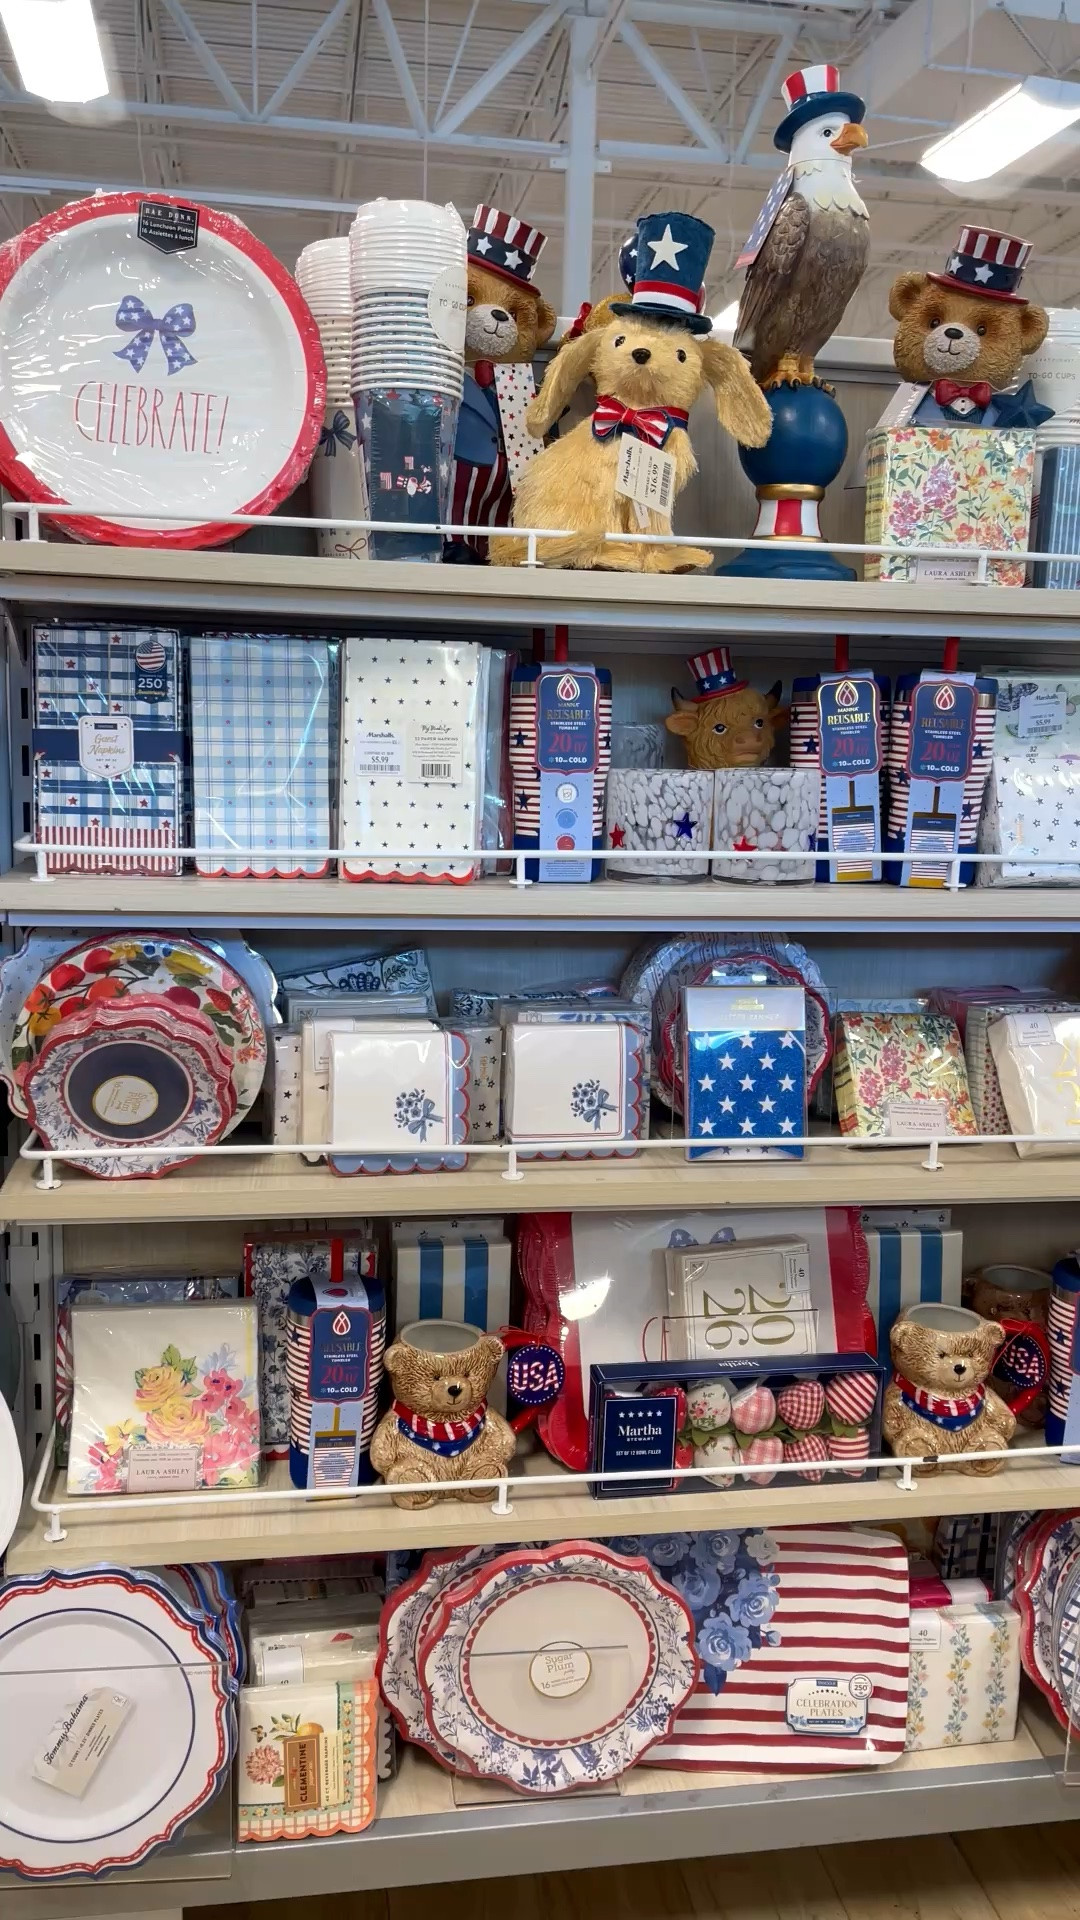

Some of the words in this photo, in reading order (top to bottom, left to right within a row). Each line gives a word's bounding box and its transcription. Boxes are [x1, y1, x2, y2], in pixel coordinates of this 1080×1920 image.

[145, 207, 162, 216] RAE
[149, 229, 174, 239] Assiettes
[150, 221, 176, 231] Luncheon
[177, 226, 194, 234] Plates
[1028, 371, 1053, 380] TO-GO
[1055, 371, 1076, 381] CUPS
[74, 380, 229, 454] CELEBRATE!
[622, 445, 634, 487] Marshalls
[649, 463, 659, 494] $16.99
[924, 569, 948, 577] LAURA
[137, 678, 163, 689] 250
[546, 709, 591, 721] REUSABLE
[827, 712, 871, 726] REUSABLE
[94, 733, 119, 744] Guest
[547, 733, 573, 753] 20
[86, 744, 127, 755] Napkins
[832, 737, 855, 758] 20
[920, 741, 945, 761] 20
[371, 756, 389, 764] $5.99
[940, 765, 960, 773] COLD
[798, 1267, 805, 1278] 40
[703, 1287, 750, 1351] 26
[748, 1284, 796, 1346] 20
[1003, 1344, 1040, 1382] USA
[321, 1365, 344, 1385] 20
[513, 1361, 559, 1391] USA
[618, 1424, 662, 1437] Martha
[136, 1468, 160, 1476] LAURA
[162, 1468, 191, 1476] ASHLEY
[918, 1629, 928, 1637] 40
[545, 1652, 574, 1665] Sugar
[547, 1662, 575, 1674] Plum
[541, 1681, 551, 1690] 16
[796, 1698, 858, 1708] CELEBRATION
[810, 1708, 844, 1717] PLATES
[43, 1727, 69, 1765] Tommy
[62, 1693, 89, 1733] Bahama
[85, 1722, 95, 1737] DINNER
[94, 1708, 104, 1723] PLATES
[299, 1743, 308, 1802] CLEMENTINE
